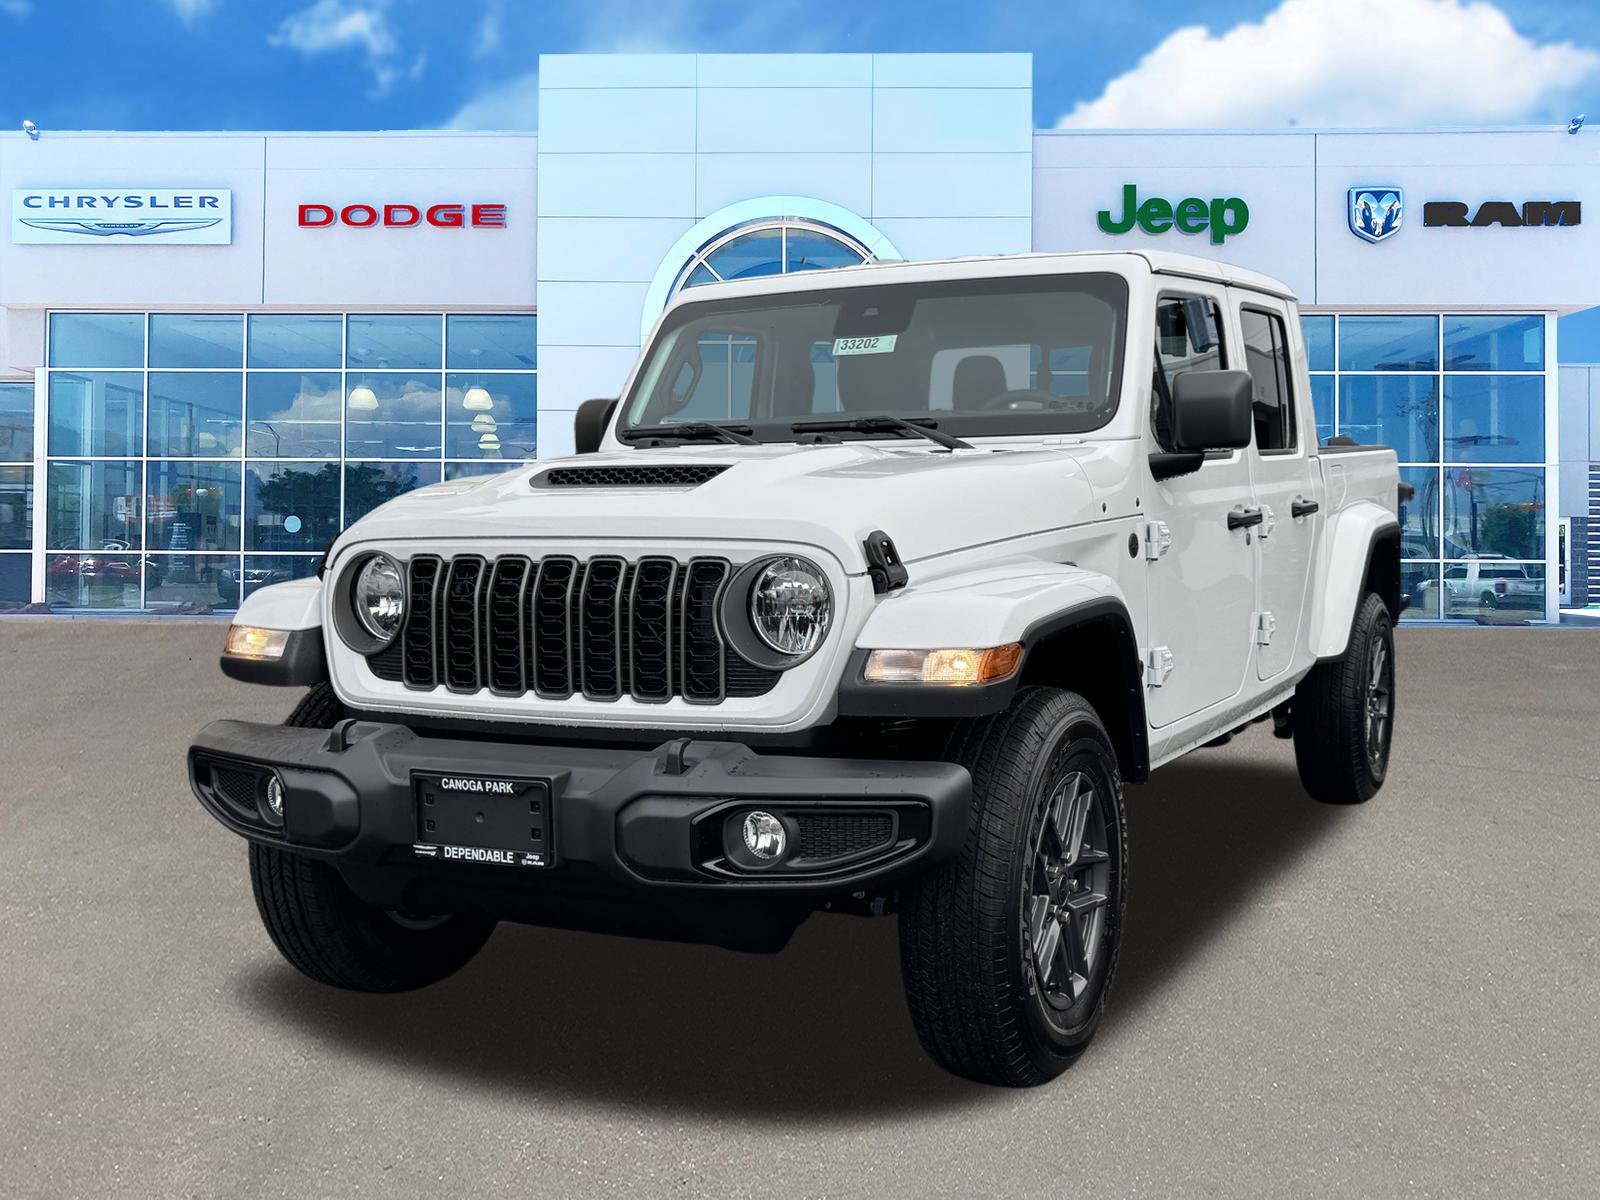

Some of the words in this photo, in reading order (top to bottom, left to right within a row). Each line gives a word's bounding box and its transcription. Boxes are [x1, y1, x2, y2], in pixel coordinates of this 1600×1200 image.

[23, 195, 220, 209] CHRYSLER
[298, 204, 507, 229] DODGE
[1097, 184, 1250, 245] Jeep
[1423, 201, 1582, 227] RAM
[840, 338, 880, 350] 33202
[442, 778, 483, 791] CANOGA
[485, 782, 514, 793] PARK
[444, 847, 514, 863] DEPENDABLE
